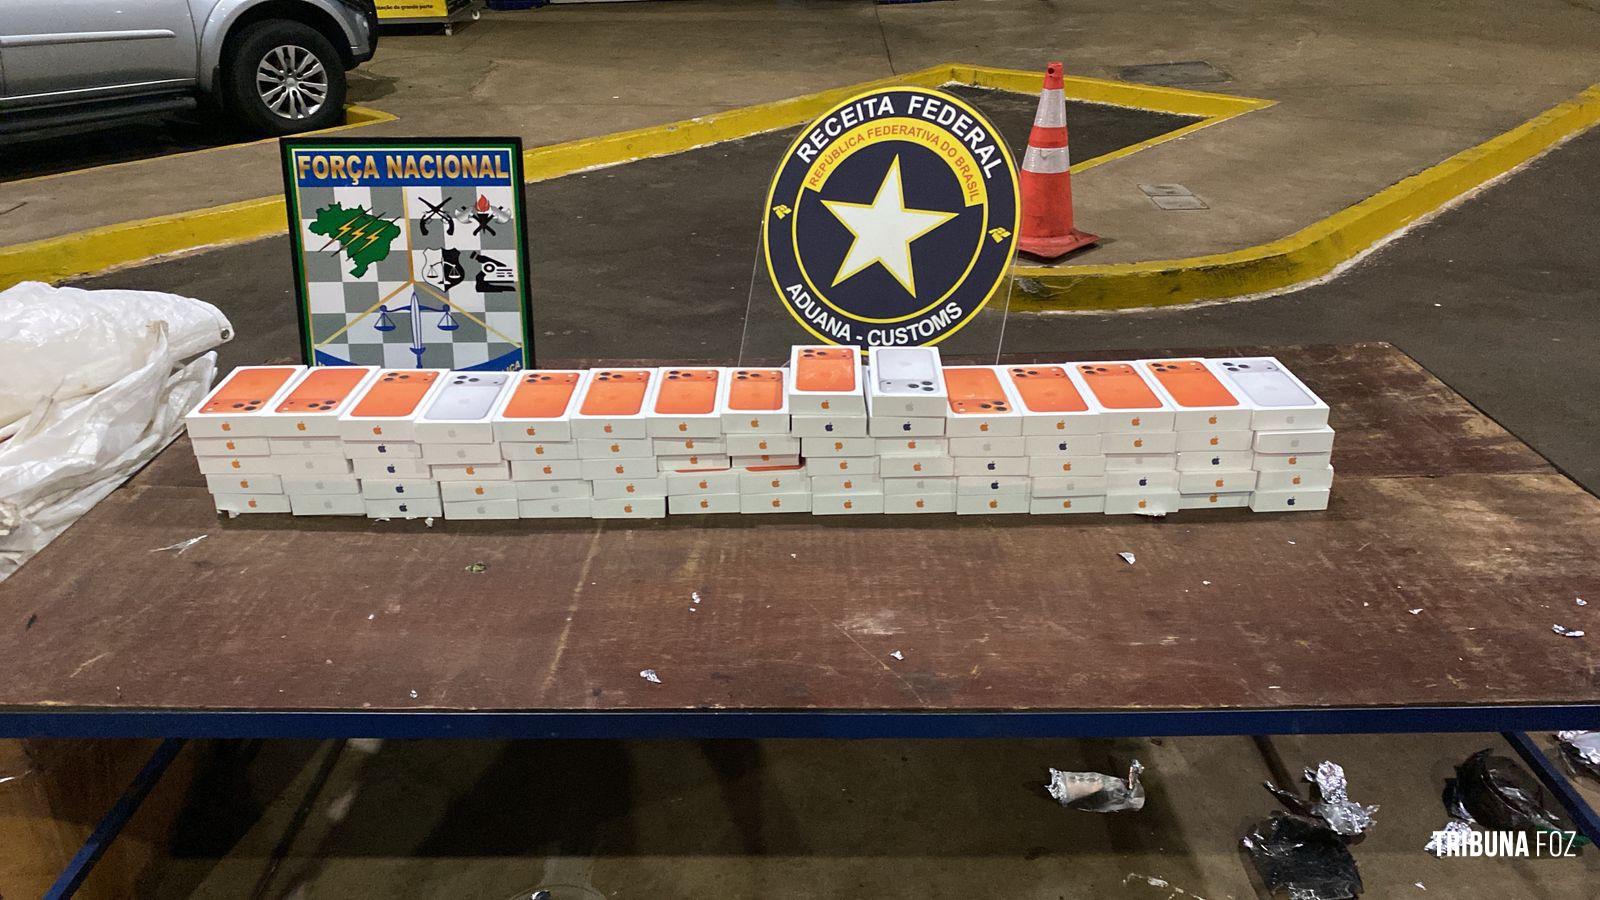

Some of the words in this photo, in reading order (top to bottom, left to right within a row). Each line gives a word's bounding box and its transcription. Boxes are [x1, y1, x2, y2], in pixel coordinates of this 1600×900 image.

[297, 155, 380, 185] FORÇA
[386, 154, 509, 179] NACIONAL
[796, 95, 895, 164] RECEITA
[907, 95, 1002, 180] FEDERAL
[809, 134, 866, 187] REPÚBLICA
[866, 124, 940, 147] FEDERATIVA
[940, 140, 957, 159] DO
[955, 156, 981, 202] BRASIL
[786, 283, 851, 342] ADUANA
[867, 301, 963, 347] CUSTOMS
